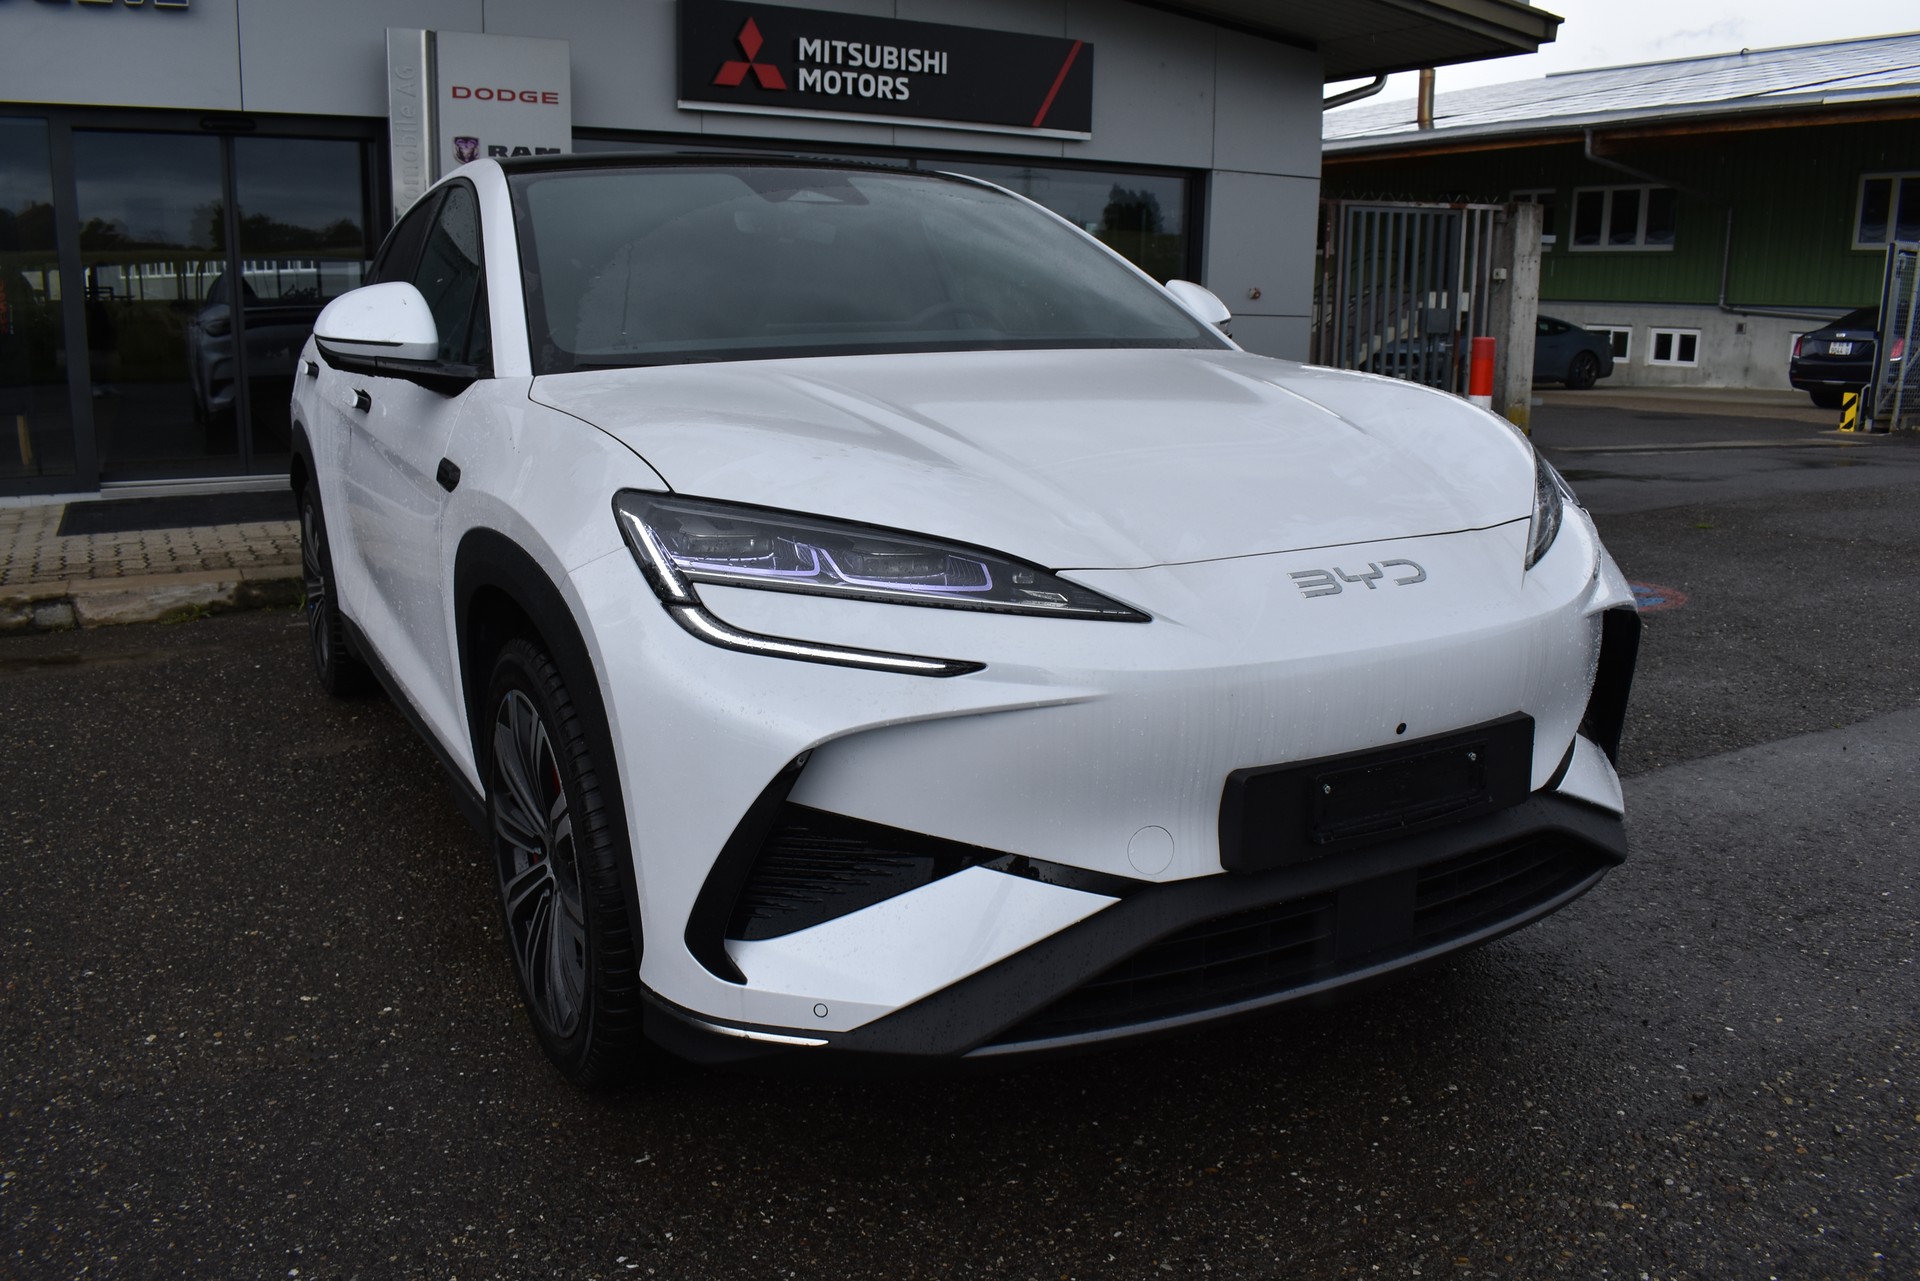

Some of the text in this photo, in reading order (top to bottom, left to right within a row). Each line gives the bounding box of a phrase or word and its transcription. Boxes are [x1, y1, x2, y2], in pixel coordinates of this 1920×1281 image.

[799, 37, 948, 75] MITSUBISHI
[394, 64, 417, 98] AG
[451, 86, 559, 105] DODGE
[799, 67, 910, 100] MOTORS
[488, 145, 561, 158] RAM
[1287, 558, 1427, 599] BYD
